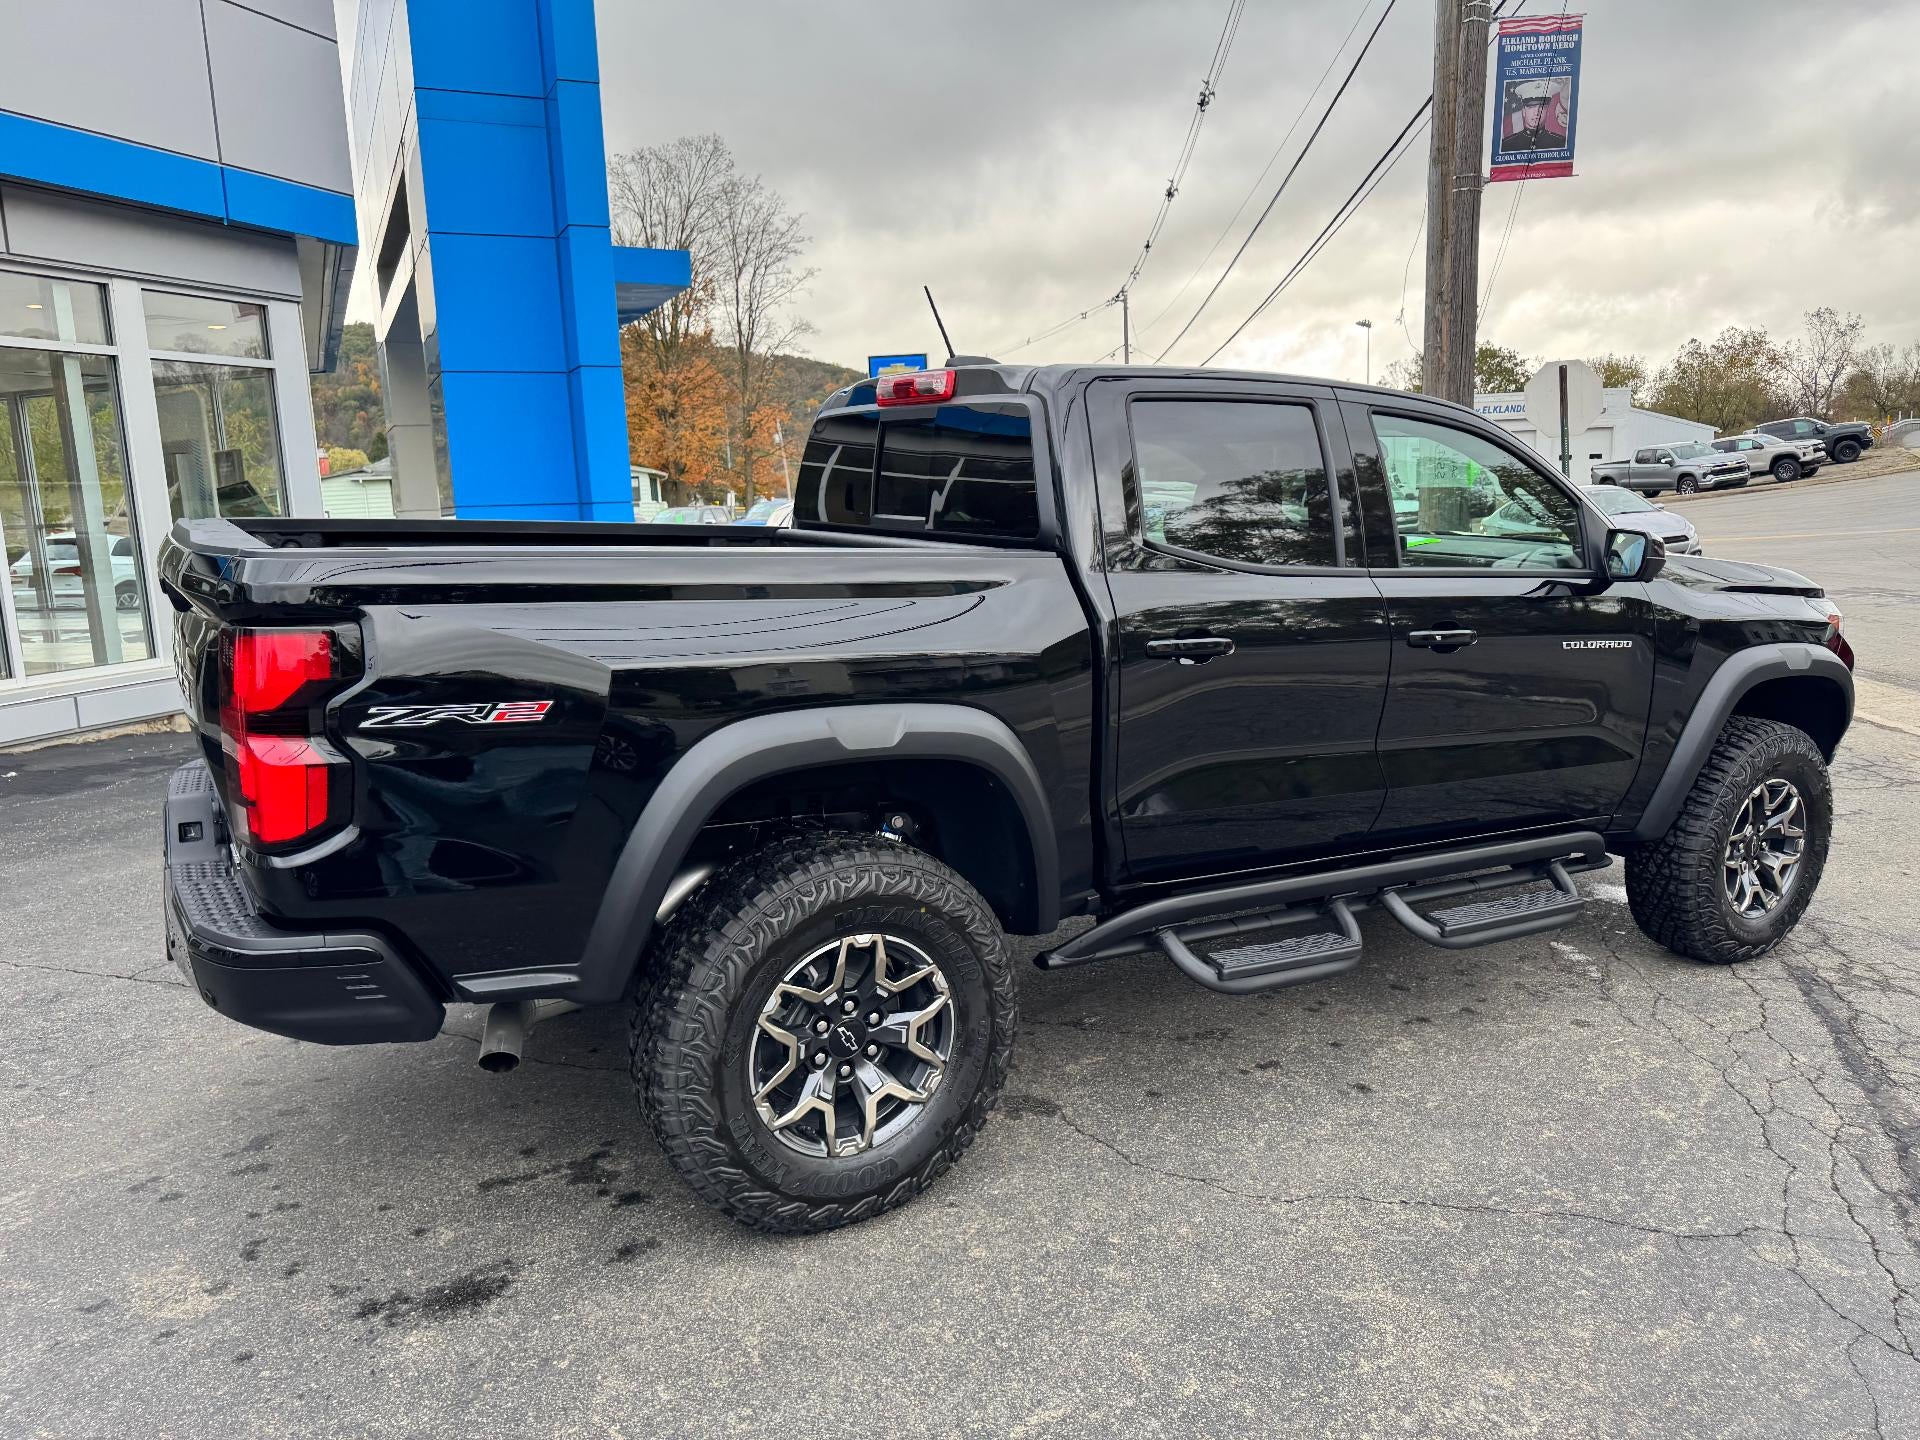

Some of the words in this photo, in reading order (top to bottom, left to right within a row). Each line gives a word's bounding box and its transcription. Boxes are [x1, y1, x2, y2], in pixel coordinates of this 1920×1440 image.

[1502, 36, 1536, 46] ELKLAND
[1538, 34, 1579, 43] BOROUGH
[1504, 43, 1550, 53] HOMETOWN
[1552, 41, 1575, 50] HERO
[1510, 58, 1542, 67] MICHAEL
[1520, 67, 1547, 75] MARINE
[1548, 65, 1571, 73] CORPS
[1562, 640, 1633, 649] COLORADO
[358, 700, 554, 728] ZR2
[833, 903, 980, 983] WRANGLER
